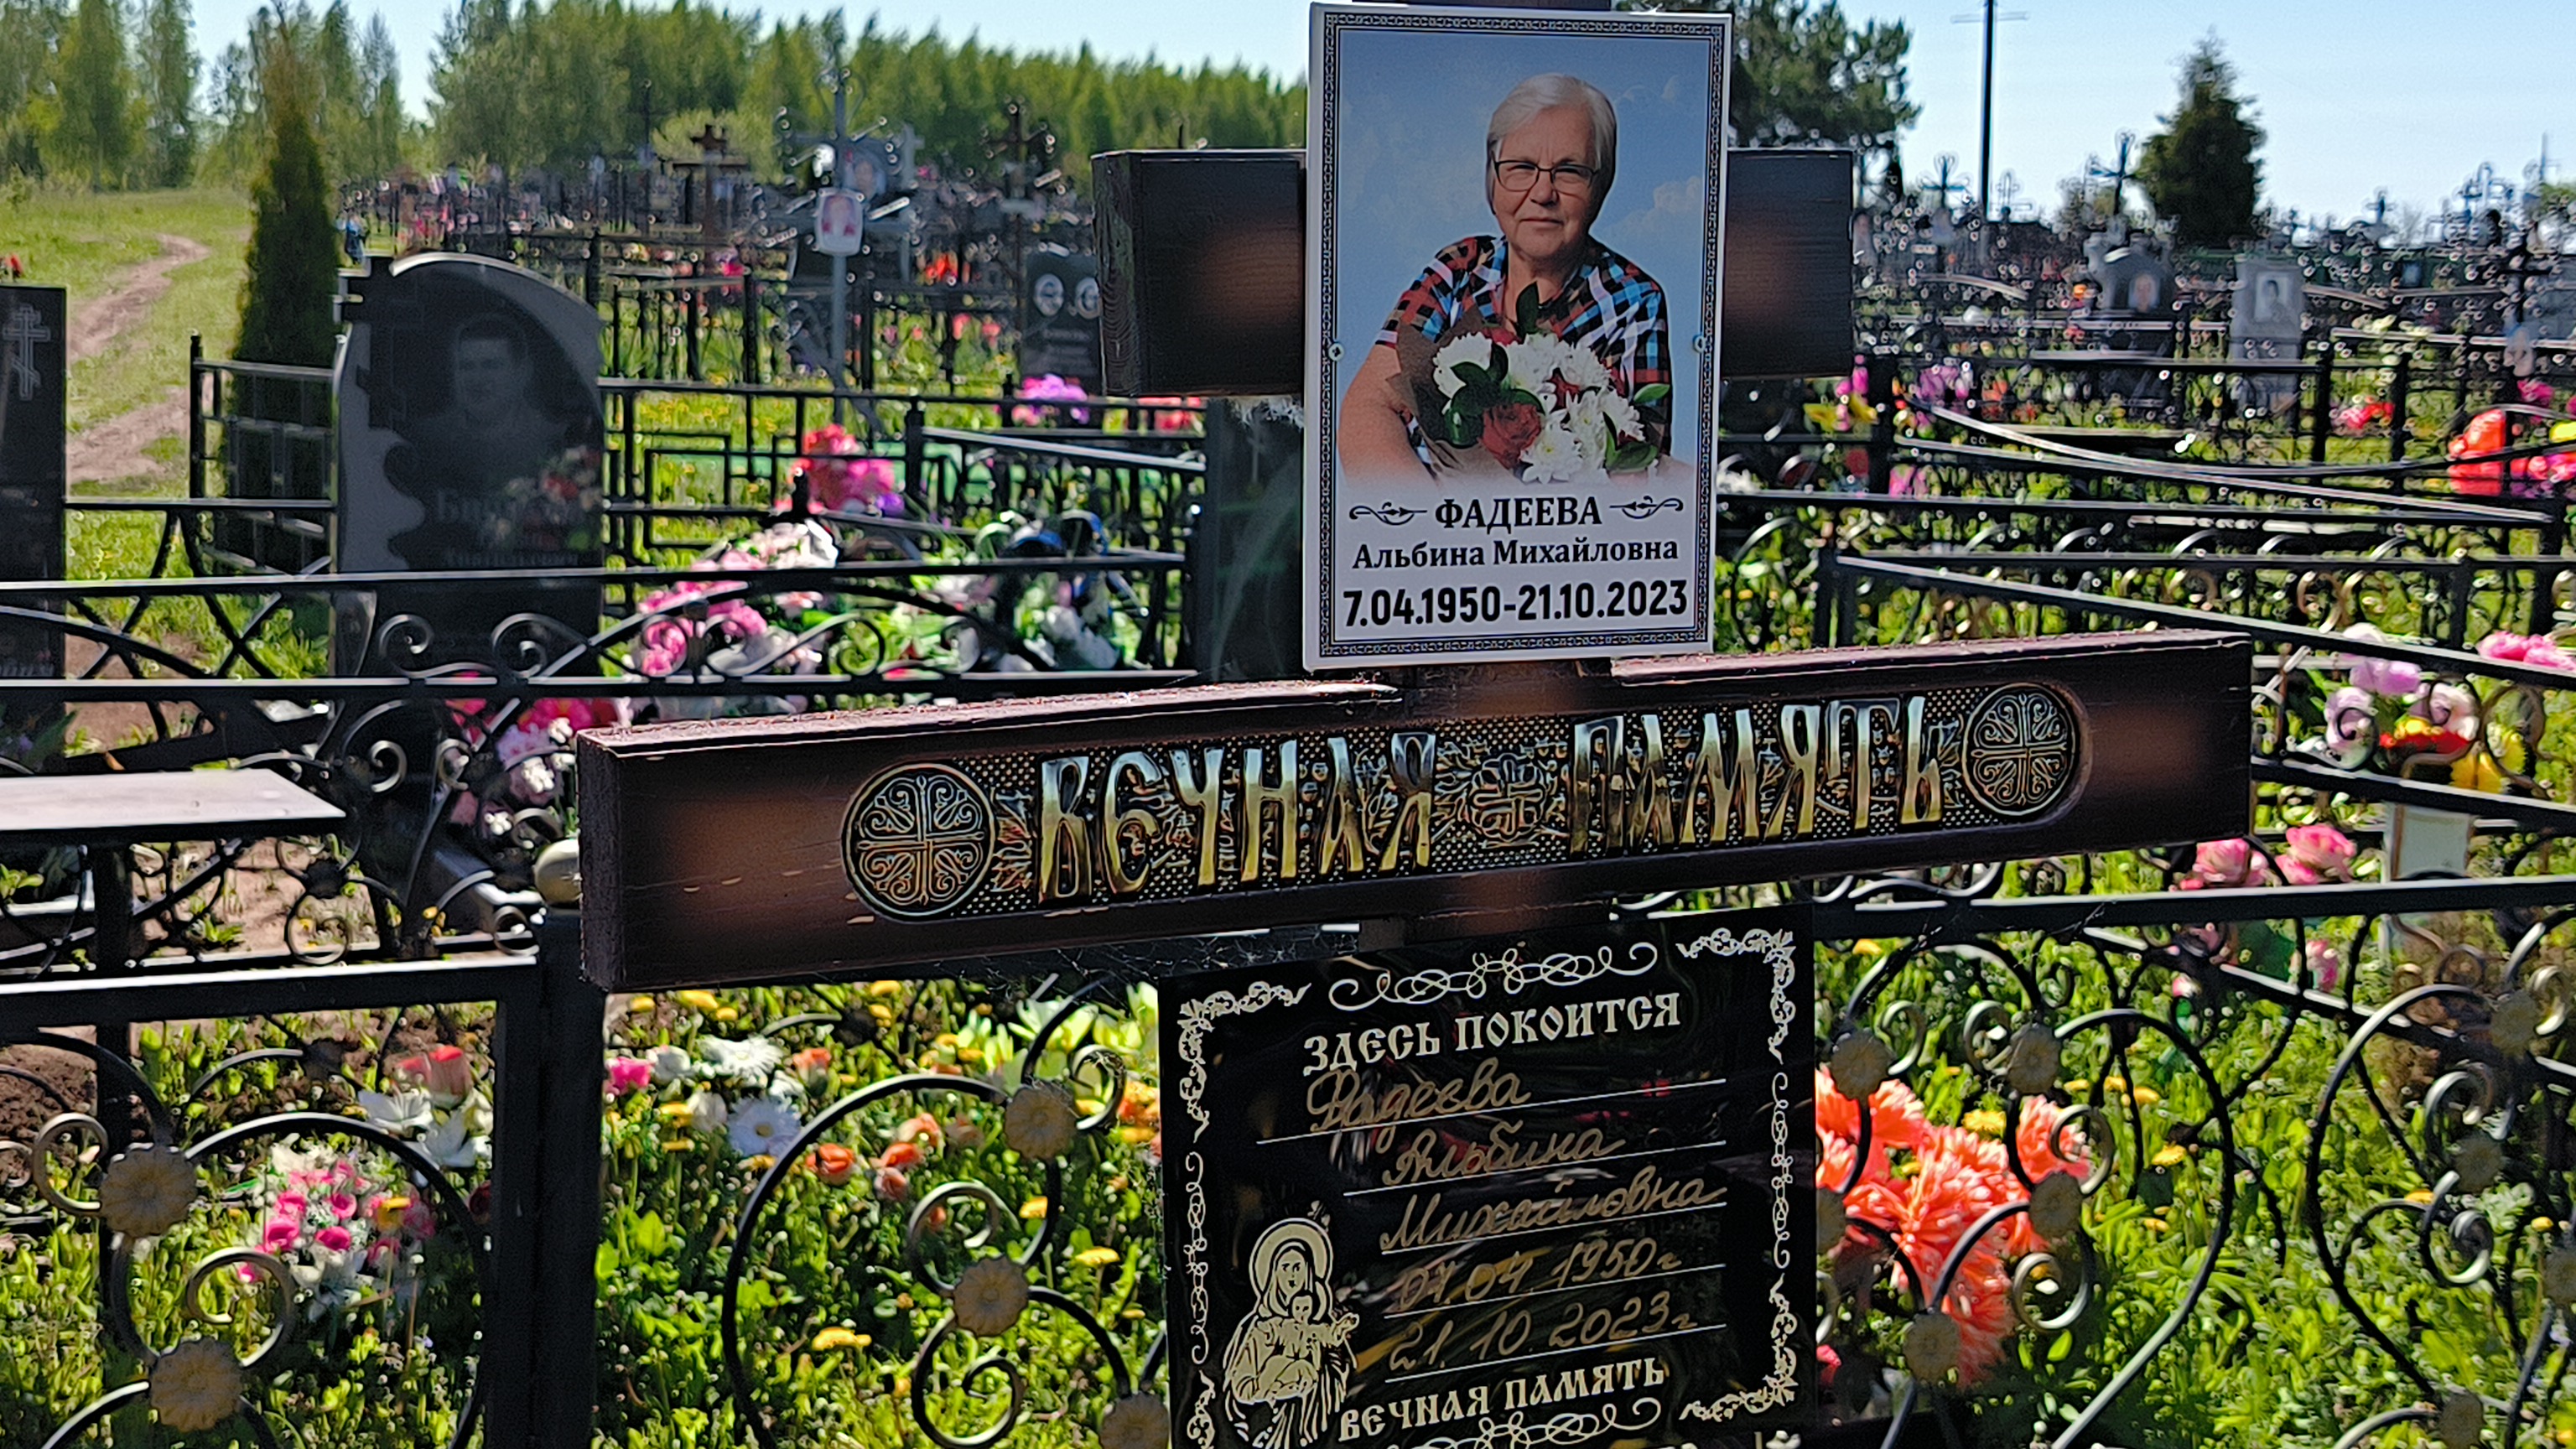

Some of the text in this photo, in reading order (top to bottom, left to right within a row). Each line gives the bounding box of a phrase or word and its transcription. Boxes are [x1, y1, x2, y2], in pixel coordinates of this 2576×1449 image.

[1352, 537, 1679, 569] Альбина Михайловна
[1435, 496, 1602, 534] ФАДЕЕВА
[1343, 579, 1687, 627] 7.04.1950-21.10.2023
[1038, 695, 1942, 904] ВЕЧНАЯ ПАМЯТЬ
[1302, 993, 1680, 1077] ЗДЕСЬ ПОКОИТСЯ
[1306, 1057, 1532, 1154] Фадеева
[1382, 1119, 1626, 1186] Альбина
[1381, 1165, 1727, 1251] Михайловна
[1338, 1357, 1665, 1442] ВЕЧНАЯ ПАМЯТЬ
